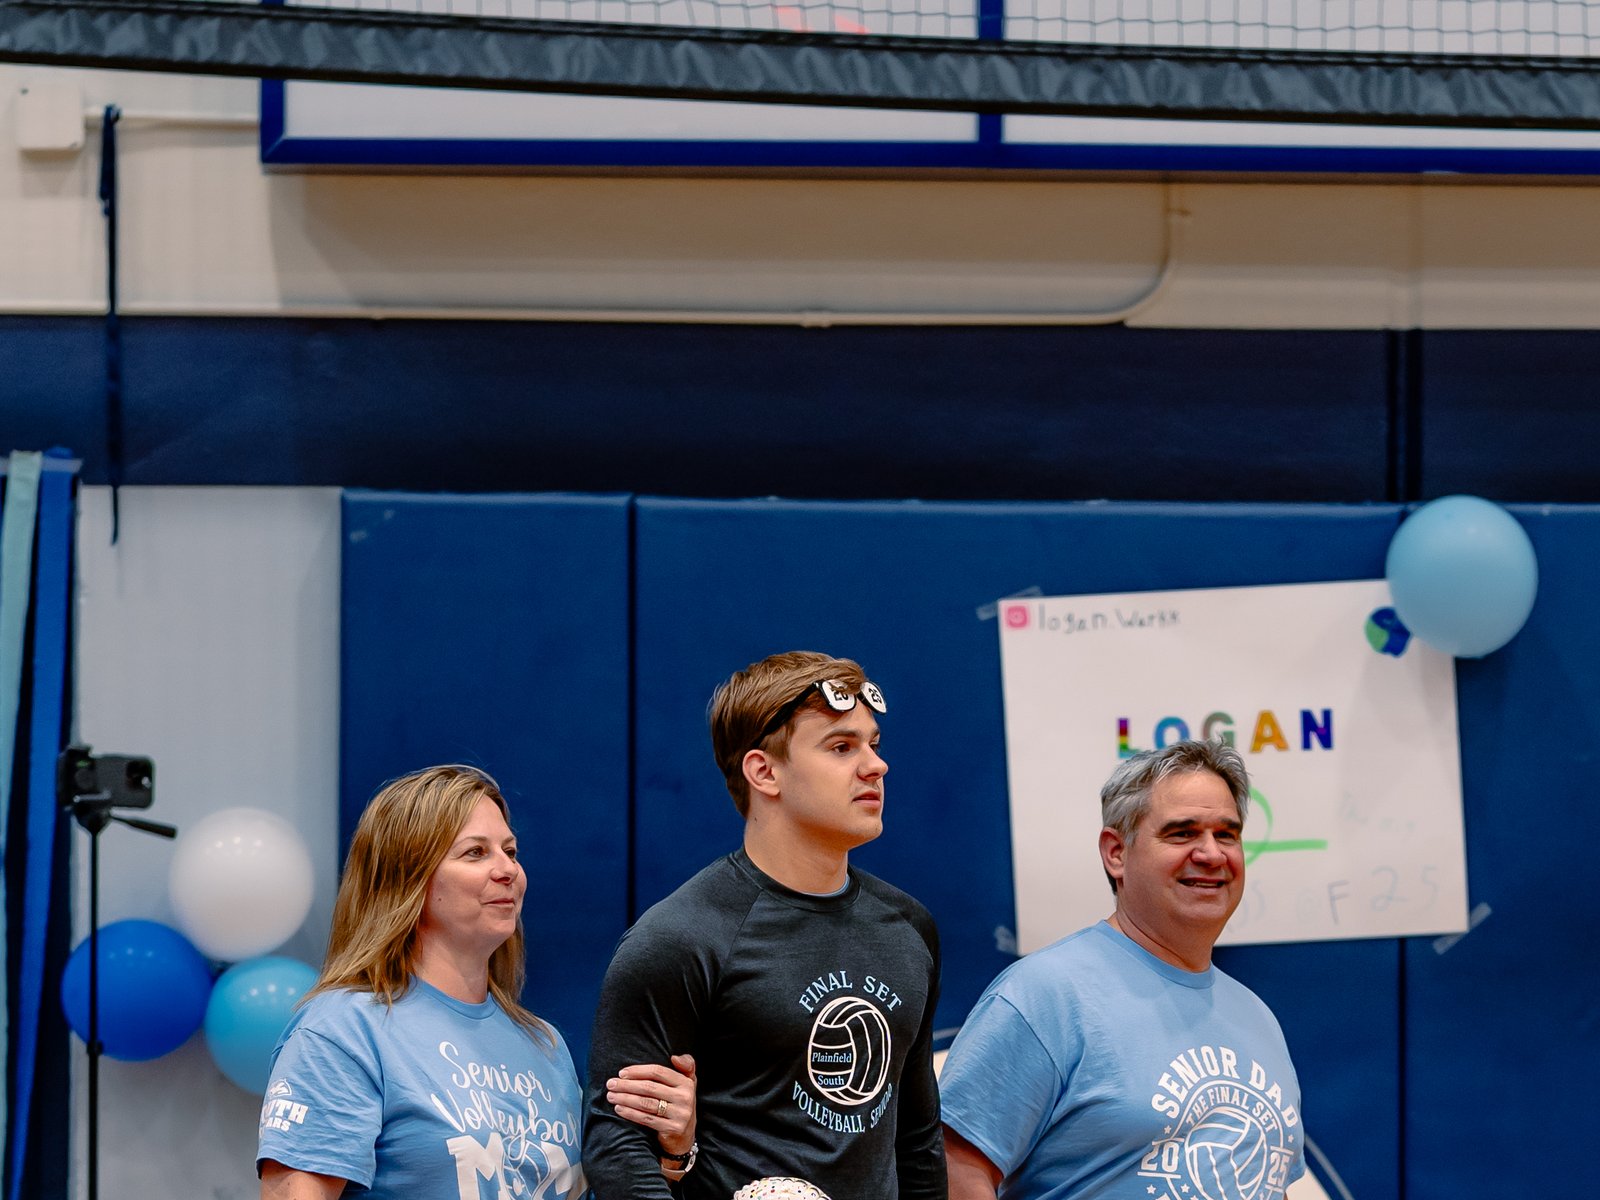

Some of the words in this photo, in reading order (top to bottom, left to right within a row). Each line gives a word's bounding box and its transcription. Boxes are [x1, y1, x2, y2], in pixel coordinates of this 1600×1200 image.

[1117, 708, 1334, 759] LOGAN
[799, 970, 853, 1014] FINAL
[863, 975, 902, 1012] SET
[439, 1041, 552, 1102] Senior
[812, 1052, 852, 1064] Plainfield
[817, 1074, 845, 1086] South
[792, 1081, 866, 1133] VOLLEYBALL
[1151, 1045, 1240, 1119] SENIOR
[1248, 1060, 1298, 1128] DAD
[1185, 1095, 1209, 1126] THE
[1206, 1086, 1250, 1111] FINAL
[1251, 1101, 1279, 1132] SET
[1141, 1141, 1180, 1173] 20
[1267, 1151, 1291, 1188] 25
